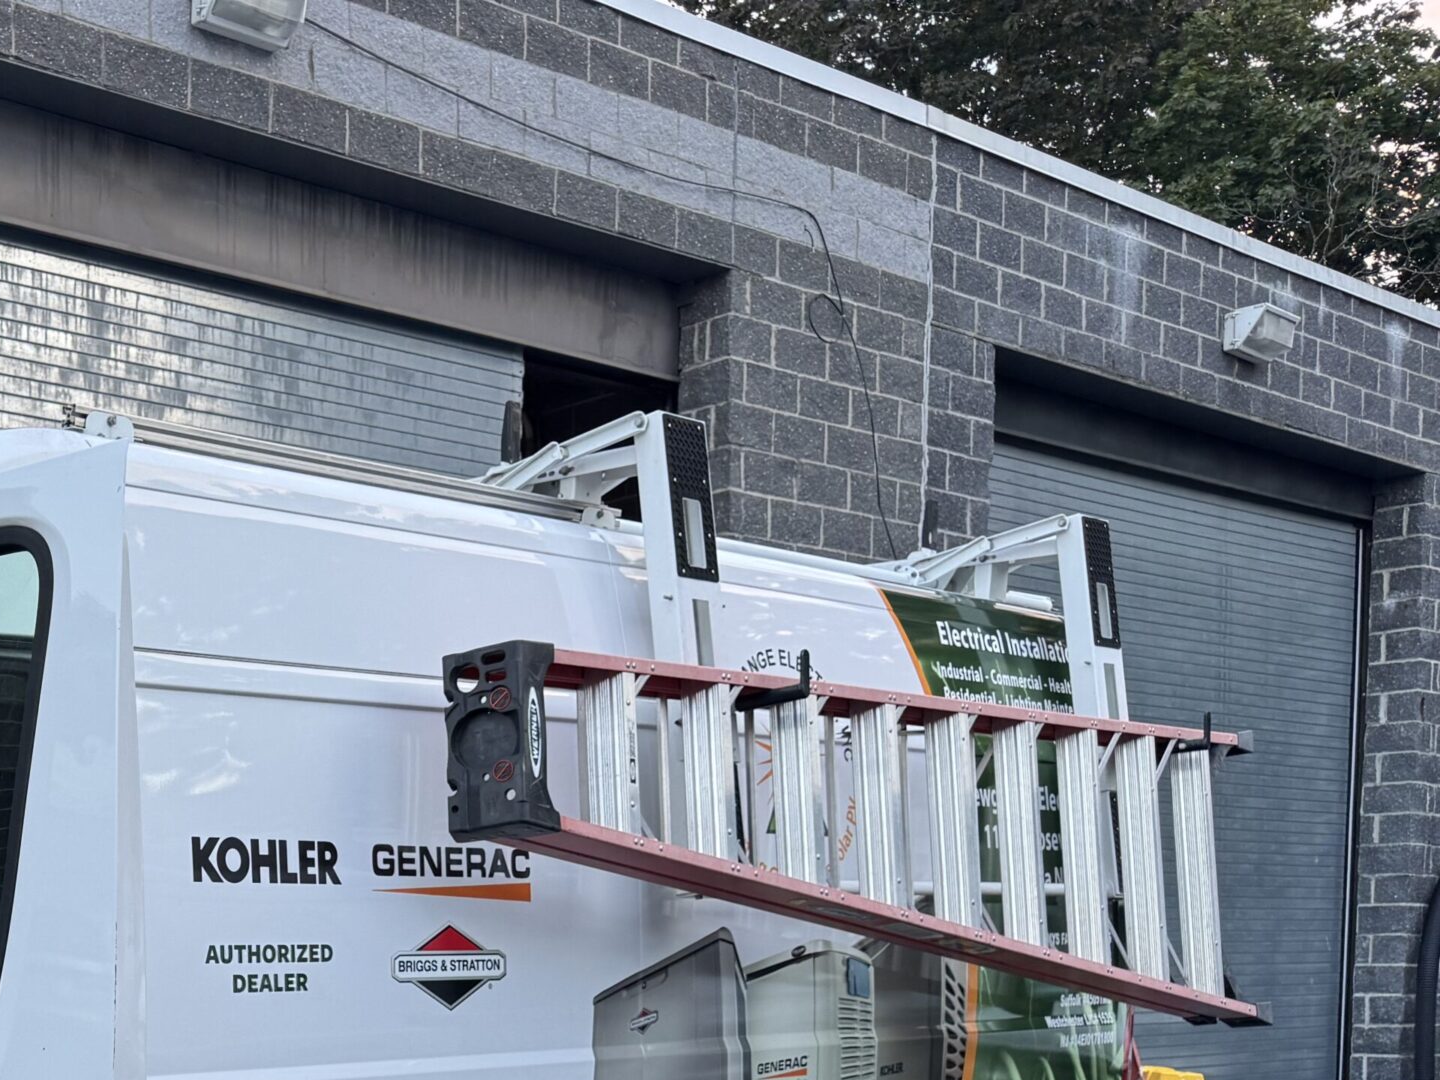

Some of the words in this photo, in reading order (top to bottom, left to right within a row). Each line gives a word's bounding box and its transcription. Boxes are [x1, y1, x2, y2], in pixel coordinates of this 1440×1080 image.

[936, 621, 1004, 654] Electrical
[936, 661, 983, 683] Industrial
[990, 668, 1042, 691] Commercial
[530, 702, 540, 760] WERNER
[191, 836, 342, 885] KOHLER
[372, 844, 531, 879] GENERAC
[205, 944, 333, 964] AUTHORIZED
[398, 960, 438, 973] BRIGGS
[440, 960, 447, 972] &
[450, 958, 501, 972] STRATTON
[232, 974, 308, 993] DEALER
[757, 1055, 808, 1075] GENERAC
